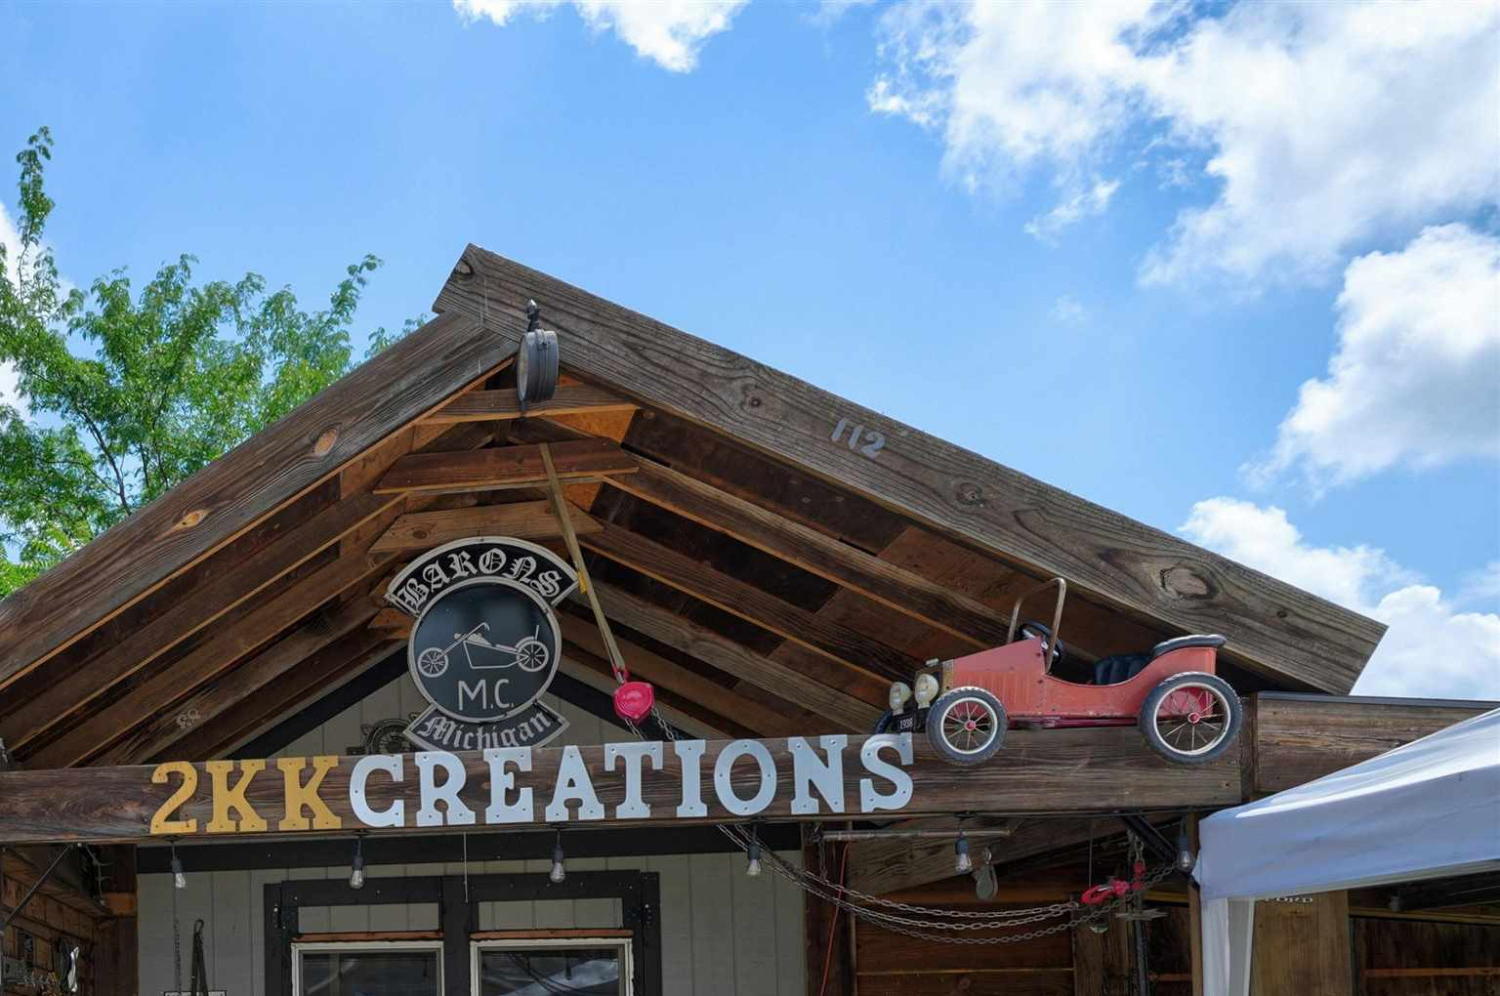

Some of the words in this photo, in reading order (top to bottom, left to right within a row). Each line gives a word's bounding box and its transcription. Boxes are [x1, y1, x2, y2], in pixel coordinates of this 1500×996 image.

[830, 417, 886, 459] 112
[398, 547, 562, 609] BARONS
[417, 711, 552, 750] Michigan
[150, 754, 342, 834] 2KK
[349, 733, 914, 827] CREATIONS
